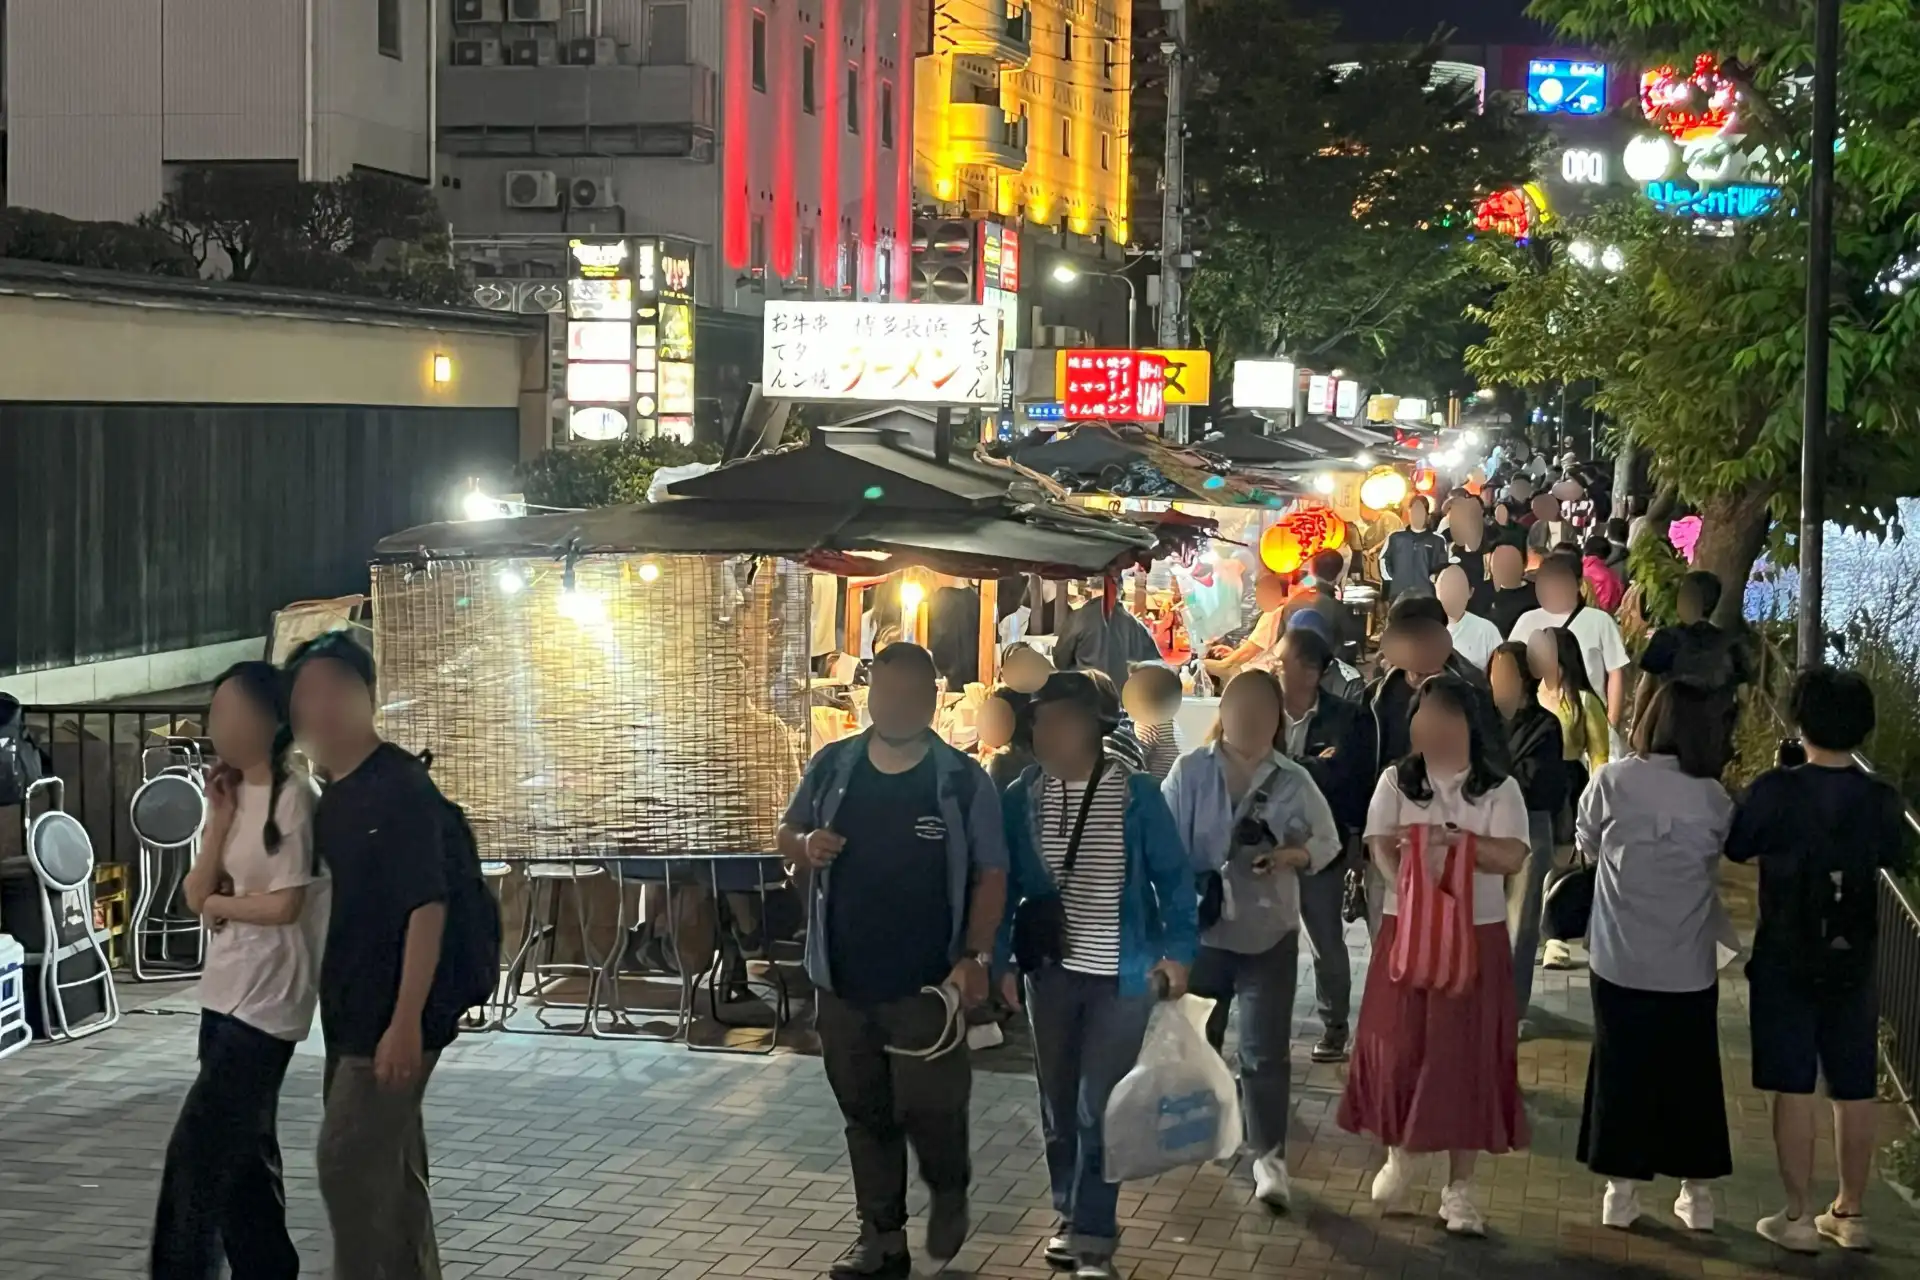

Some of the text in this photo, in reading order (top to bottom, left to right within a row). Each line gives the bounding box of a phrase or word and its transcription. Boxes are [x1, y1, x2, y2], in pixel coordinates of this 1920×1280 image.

[791, 312, 810, 388] 牛タン
[854, 315, 950, 339] 博多長浜
[839, 346, 962, 393] ラーメン
[966, 313, 991, 399] 大ちゃん
[1119, 357, 1131, 414] ラーメン
